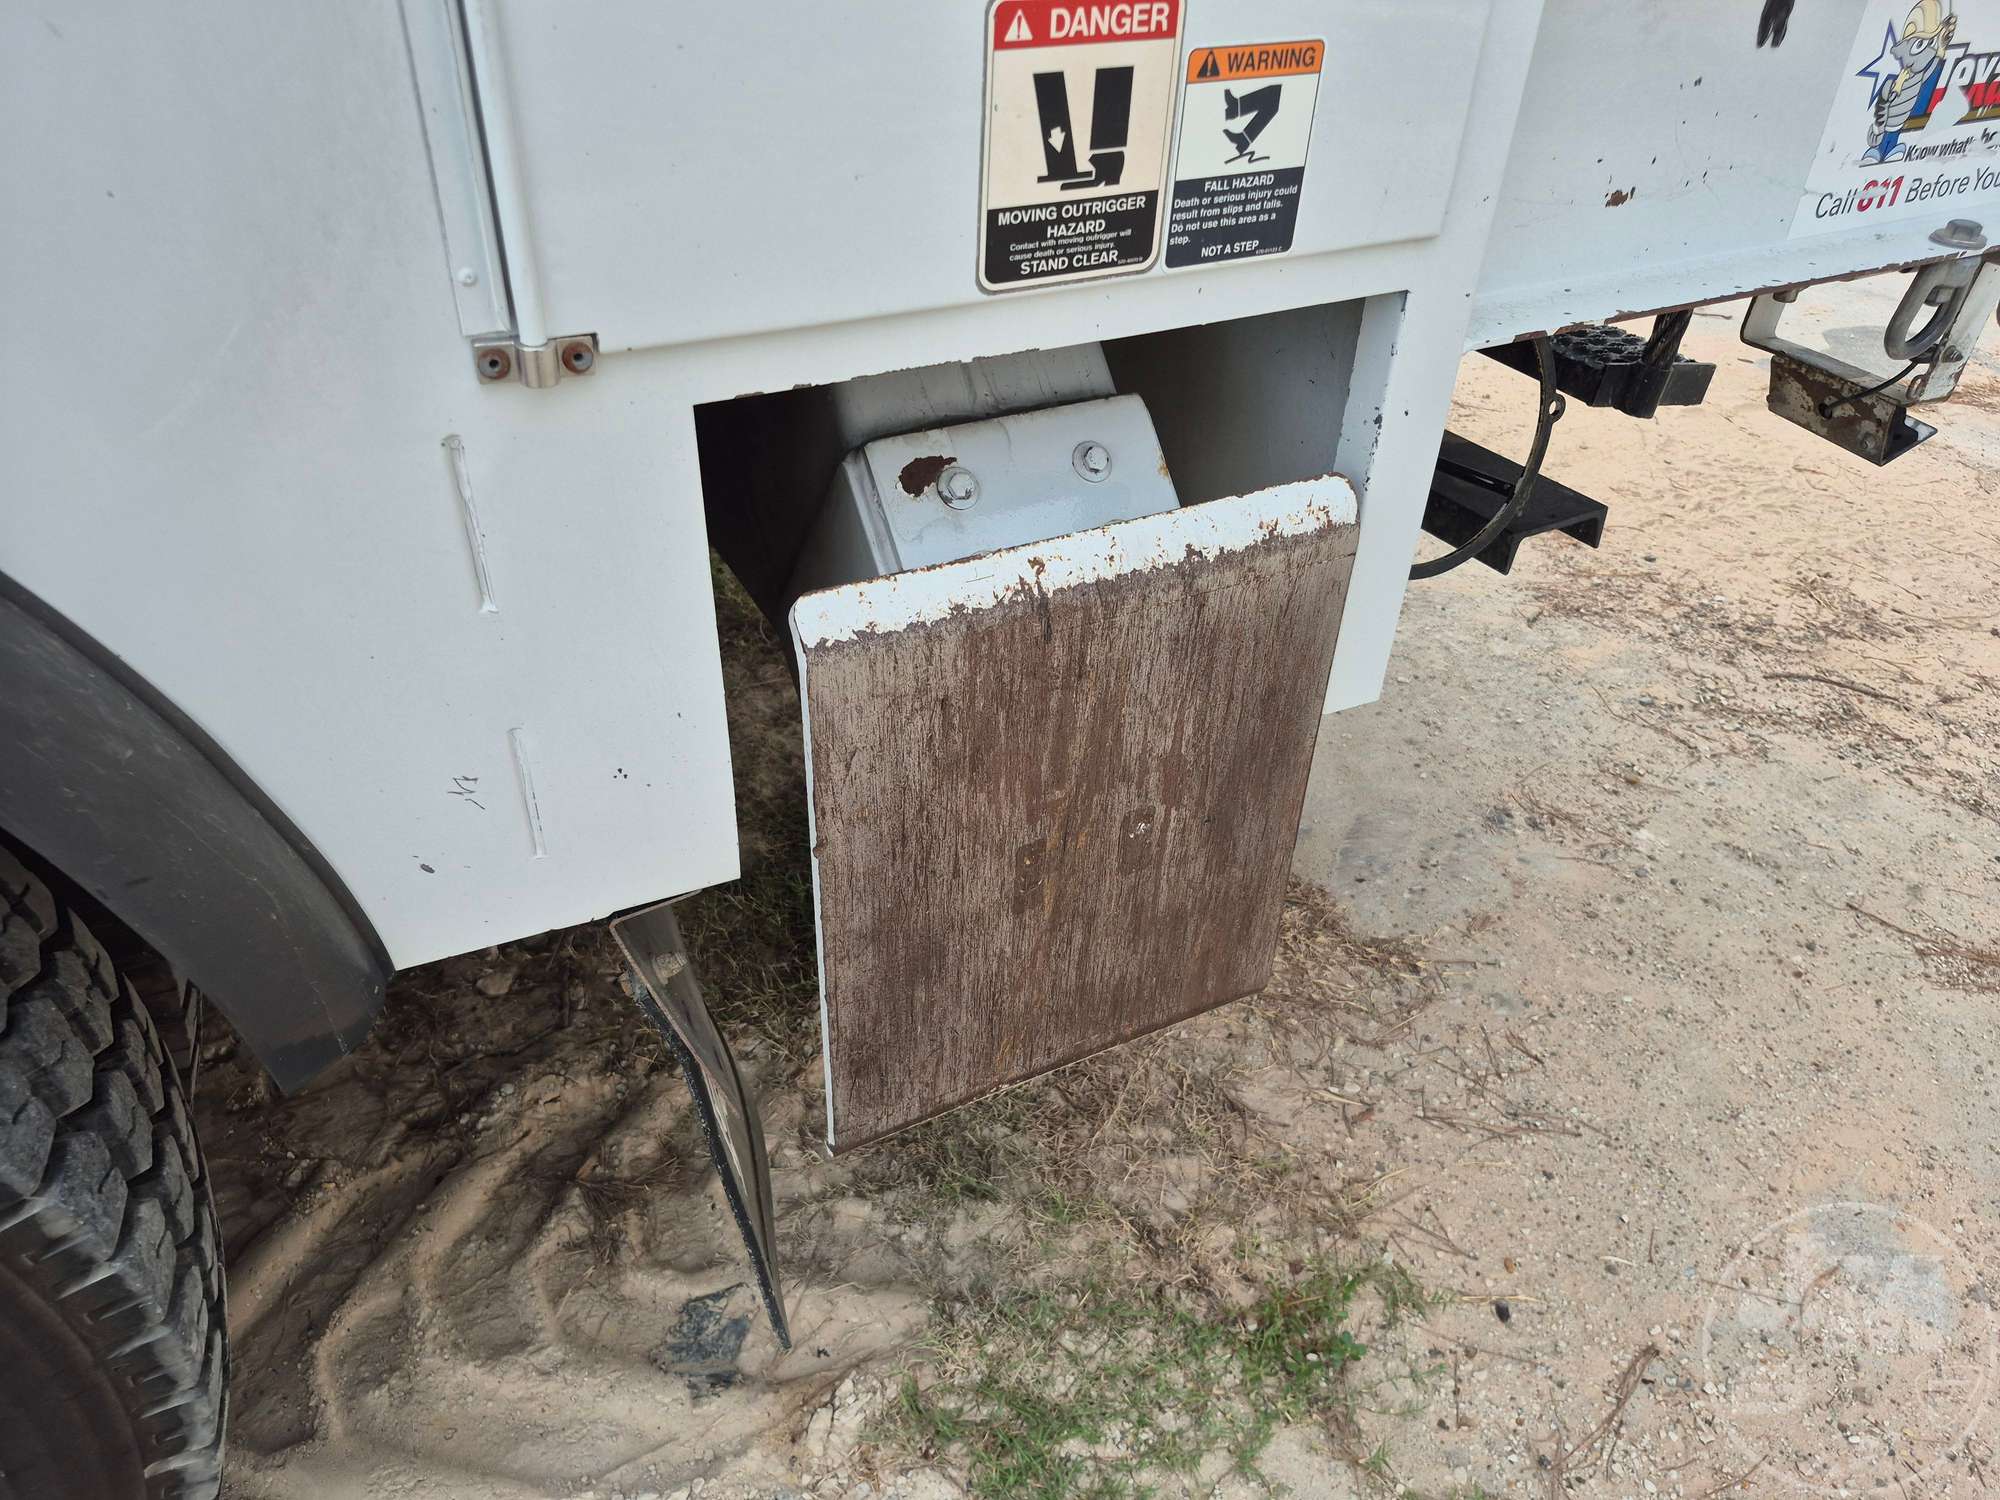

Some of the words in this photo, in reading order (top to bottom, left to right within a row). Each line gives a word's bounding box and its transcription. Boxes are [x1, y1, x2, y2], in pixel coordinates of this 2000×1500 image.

[1049, 3, 1170, 39] DANGER
[1227, 46, 1316, 73] WARNING
[1204, 181, 1230, 192] FALL
[1232, 174, 1275, 189] HAZARD
[1173, 197, 1200, 209] Death
[1201, 197, 1212, 206] or
[1213, 192, 1246, 204] serious
[1247, 188, 1273, 201] injury
[1274, 185, 1298, 197] could
[1815, 188, 1859, 218] Call
[1904, 173, 1970, 203] Before
[998, 206, 1057, 226] MOVING
[1061, 195, 1146, 218] OUTRIGGER
[1172, 209, 1198, 221] result
[1200, 207, 1220, 217] from
[1222, 203, 1244, 216] slips
[1244, 201, 1261, 212] and
[1263, 198, 1283, 209] falls.
[1046, 219, 1106, 238] HAZARD
[1171, 222, 1183, 233] Do
[1185, 220, 1200, 231] not
[1202, 219, 1218, 229] use
[1220, 216, 1236, 227] this
[1238, 215, 1256, 225] area
[1258, 214, 1269, 222] as
[1270, 212, 1276, 220] a
[1009, 252, 1032, 262] cause
[1034, 249, 1055, 259] death
[1056, 247, 1064, 255] or
[1066, 244, 1093, 254] serious
[1094, 241, 1115, 251] injury.
[1010, 240, 1039, 252] Contact
[1040, 237, 1056, 248] with
[1058, 235, 1084, 247] moving
[1085, 231, 1118, 243] outrigger
[1119, 228, 1132, 237] will
[1169, 236, 1191, 246] step.
[1201, 243, 1223, 257] NOT
[1223, 242, 1232, 254] A
[1233, 239, 1260, 253] STEP
[1020, 256, 1069, 275] STAND
[1072, 250, 1119, 268] CLEAR
